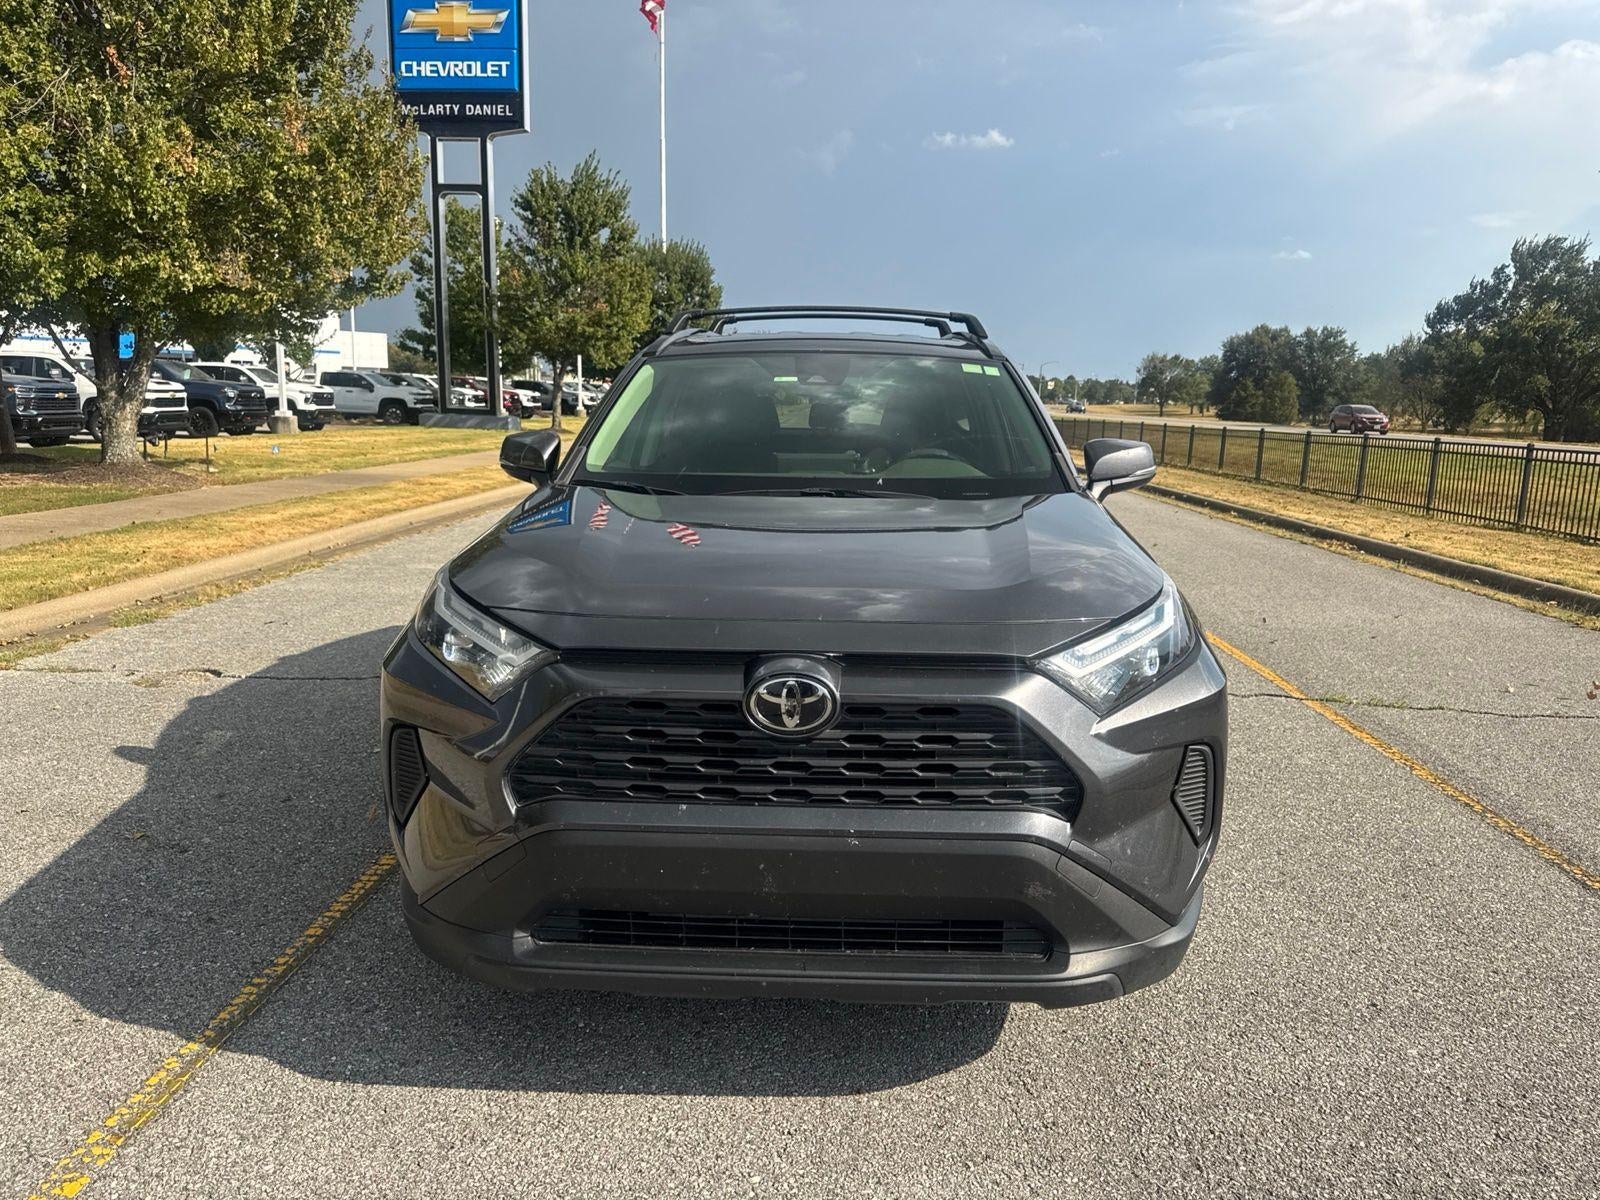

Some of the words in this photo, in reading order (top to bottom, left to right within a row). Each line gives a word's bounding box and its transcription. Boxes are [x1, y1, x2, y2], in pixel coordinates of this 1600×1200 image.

[401, 61, 510, 77] CHEVROLET
[401, 104, 460, 116] McLARTY
[466, 104, 513, 116] DANIEL
